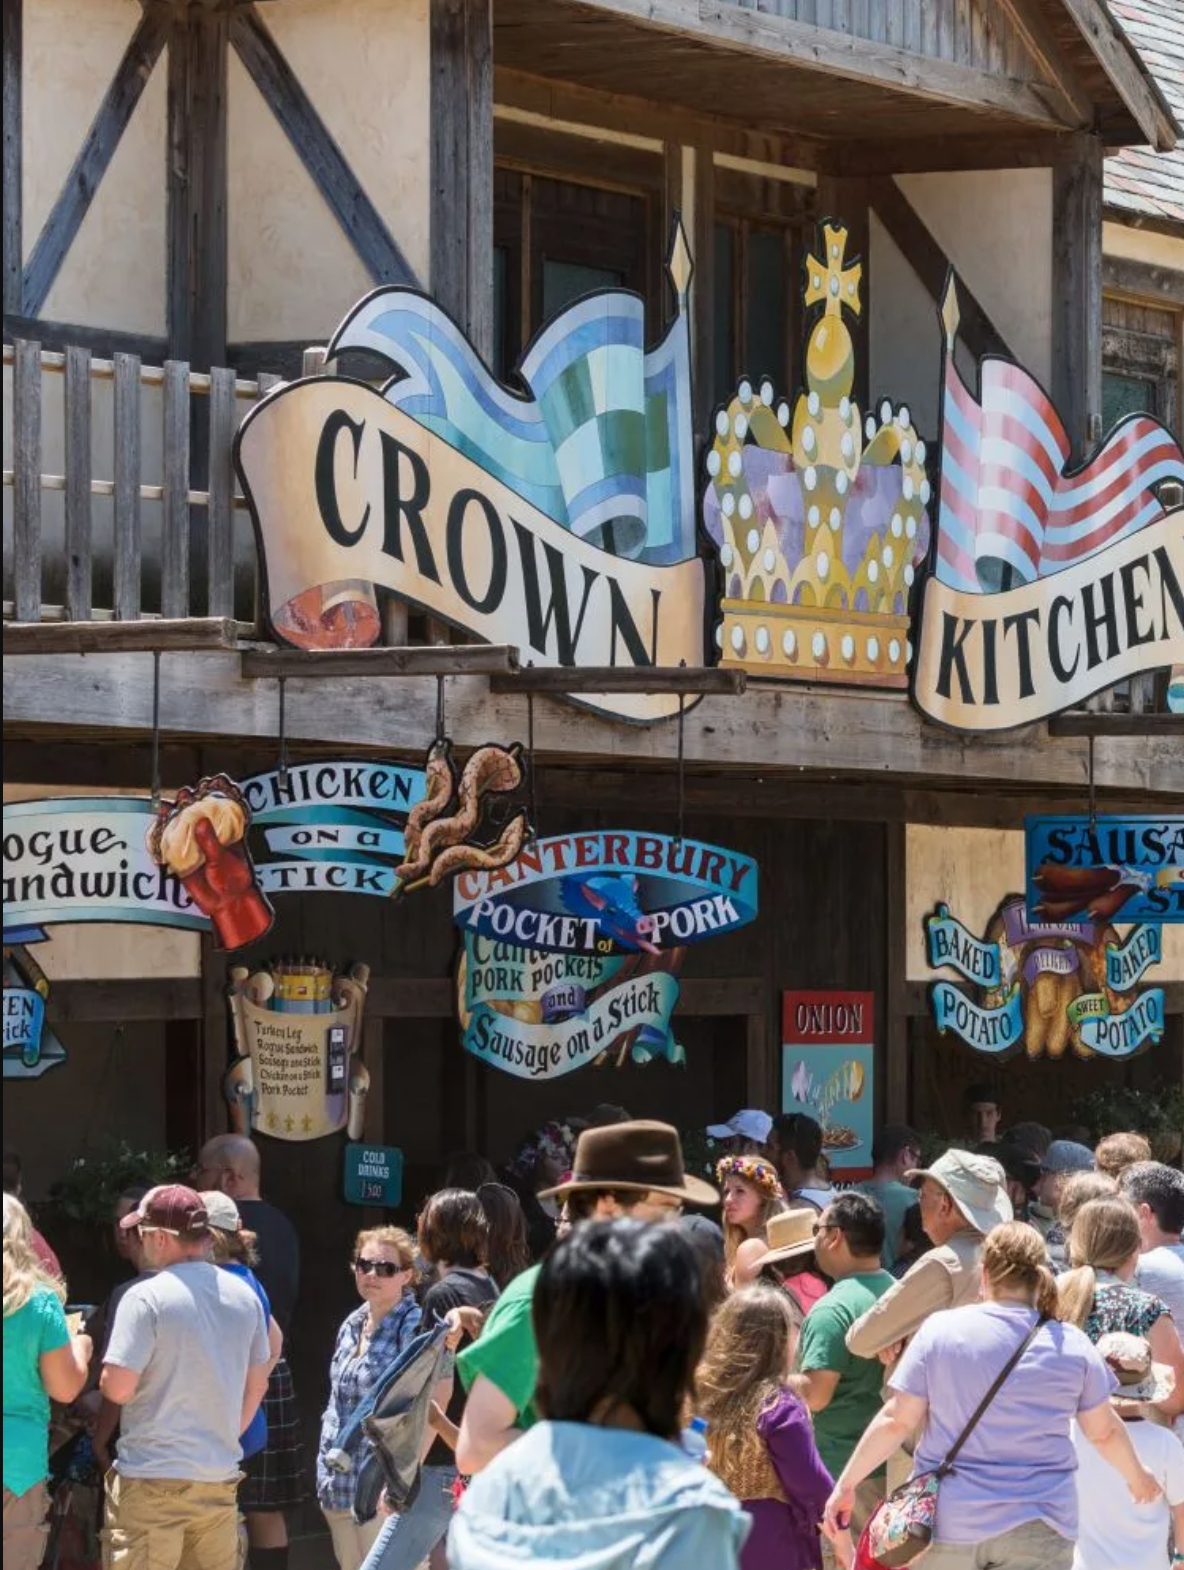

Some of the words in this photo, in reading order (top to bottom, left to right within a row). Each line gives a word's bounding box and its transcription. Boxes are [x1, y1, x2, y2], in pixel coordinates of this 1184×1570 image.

[314, 408, 662, 668] CROWN
[244, 766, 413, 812] CHICKEN
[3, 827, 127, 865] ogue
[291, 829, 339, 846] ON
[458, 834, 750, 900] CANTERBURY
[467, 900, 601, 949] POCKET
[597, 938, 614, 953] of
[650, 894, 740, 944] PORK
[933, 928, 996, 981] BAKED
[1111, 926, 1159, 985] BAKED
[471, 967, 524, 998] PORK
[548, 986, 576, 1008] and
[3, 996, 35, 1018] EN
[797, 1003, 864, 1036] ONION
[943, 990, 1013, 1047] POTATO
[1076, 997, 1104, 1017] SWEET
[1096, 997, 1158, 1050] POTATO
[3, 1019, 33, 1041] ick
[470, 1012, 561, 1076] Sausage
[567, 1029, 591, 1059] on
[593, 1021, 605, 1042] a
[605, 981, 662, 1034] Stick
[357, 1163, 390, 1179] DRINKS
[363, 1150, 386, 1165] COLD
